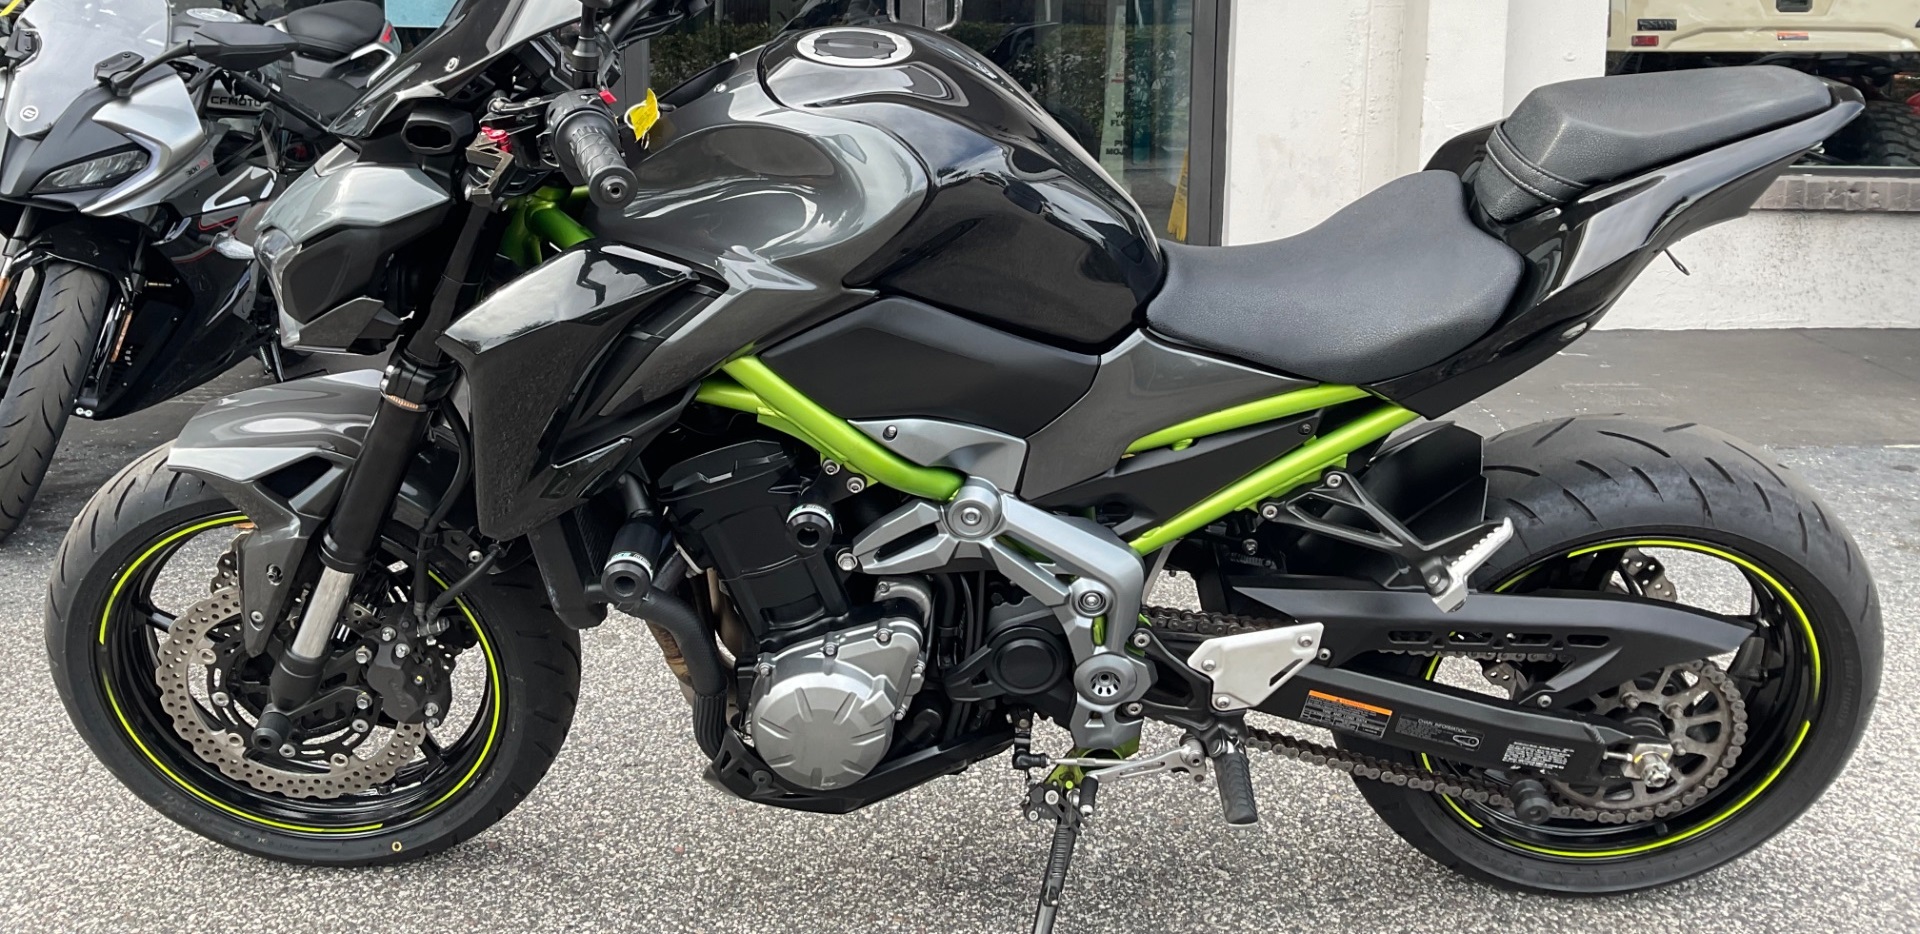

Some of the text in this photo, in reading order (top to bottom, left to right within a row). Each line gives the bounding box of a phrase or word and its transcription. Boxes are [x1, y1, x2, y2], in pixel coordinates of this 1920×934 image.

[210, 95, 262, 107] CFMOTO
[1417, 718, 1468, 734] CHAIN INFORMATION
